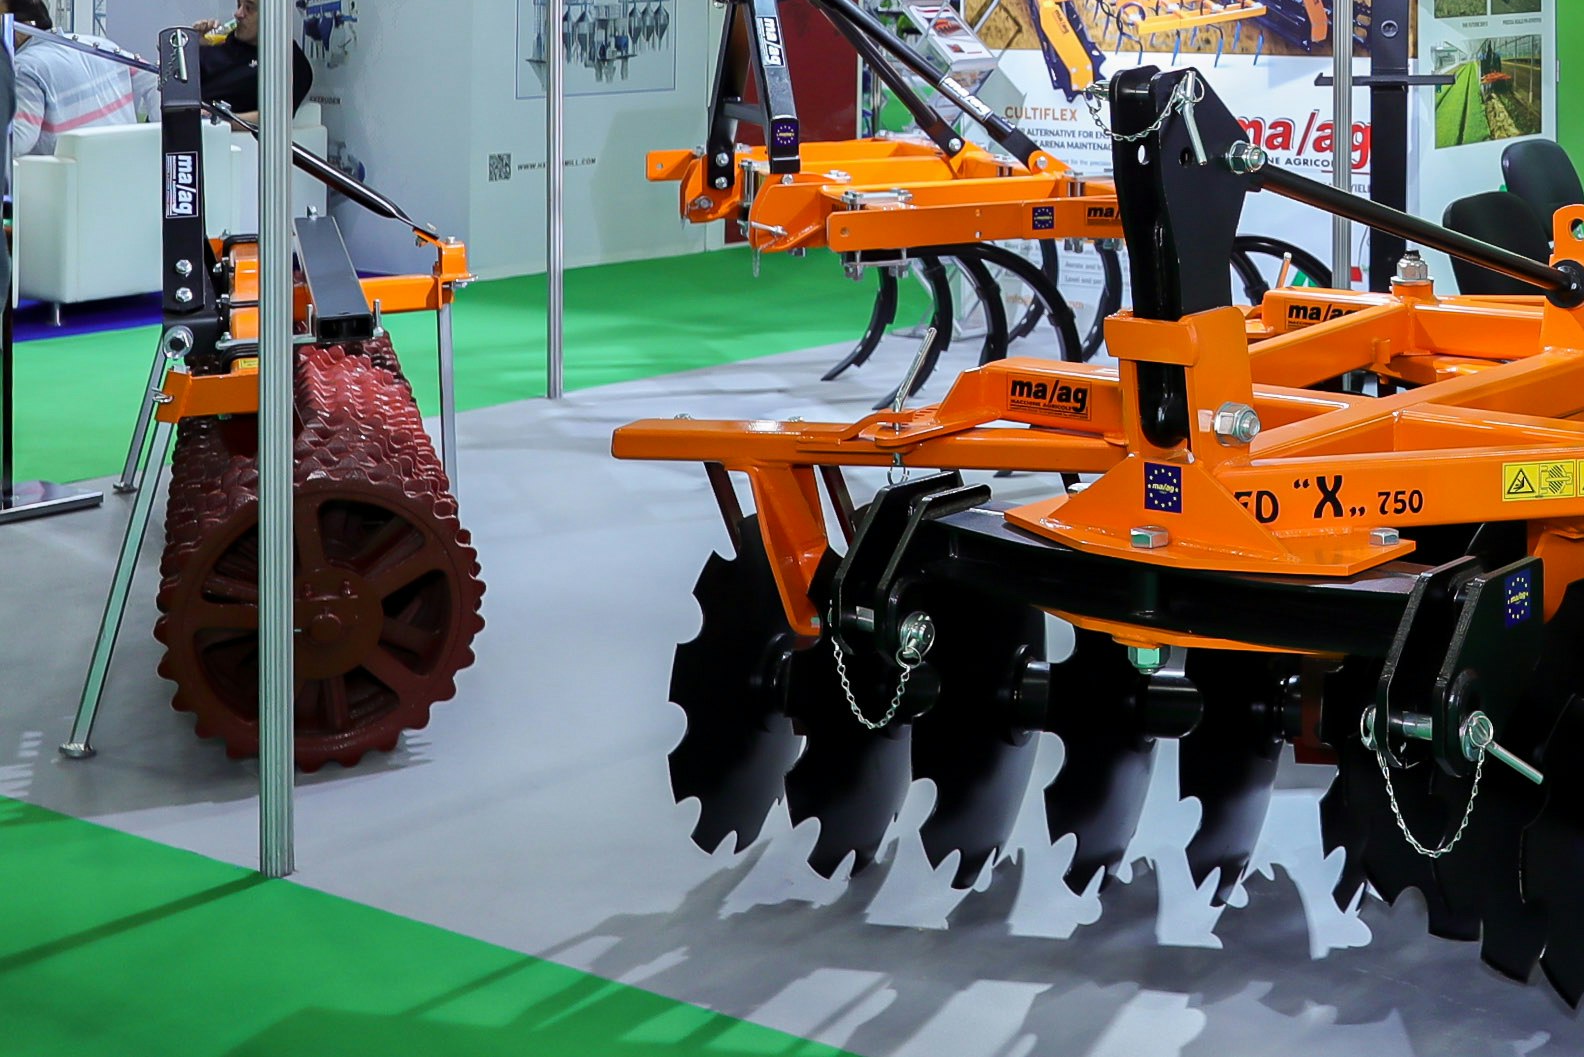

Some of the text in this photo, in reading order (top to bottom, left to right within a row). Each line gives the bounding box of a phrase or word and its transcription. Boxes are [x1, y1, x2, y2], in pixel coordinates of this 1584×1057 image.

[1005, 106, 1077, 121] CULTIFLEX
[1027, 128, 1076, 137] ALTERNATIVE
[1078, 130, 1093, 138] FOR
[1040, 140, 1065, 149] ARENA
[172, 155, 196, 214] ma/ag
[1011, 379, 1088, 412] ma/ag
[1377, 489, 1423, 515] 750
